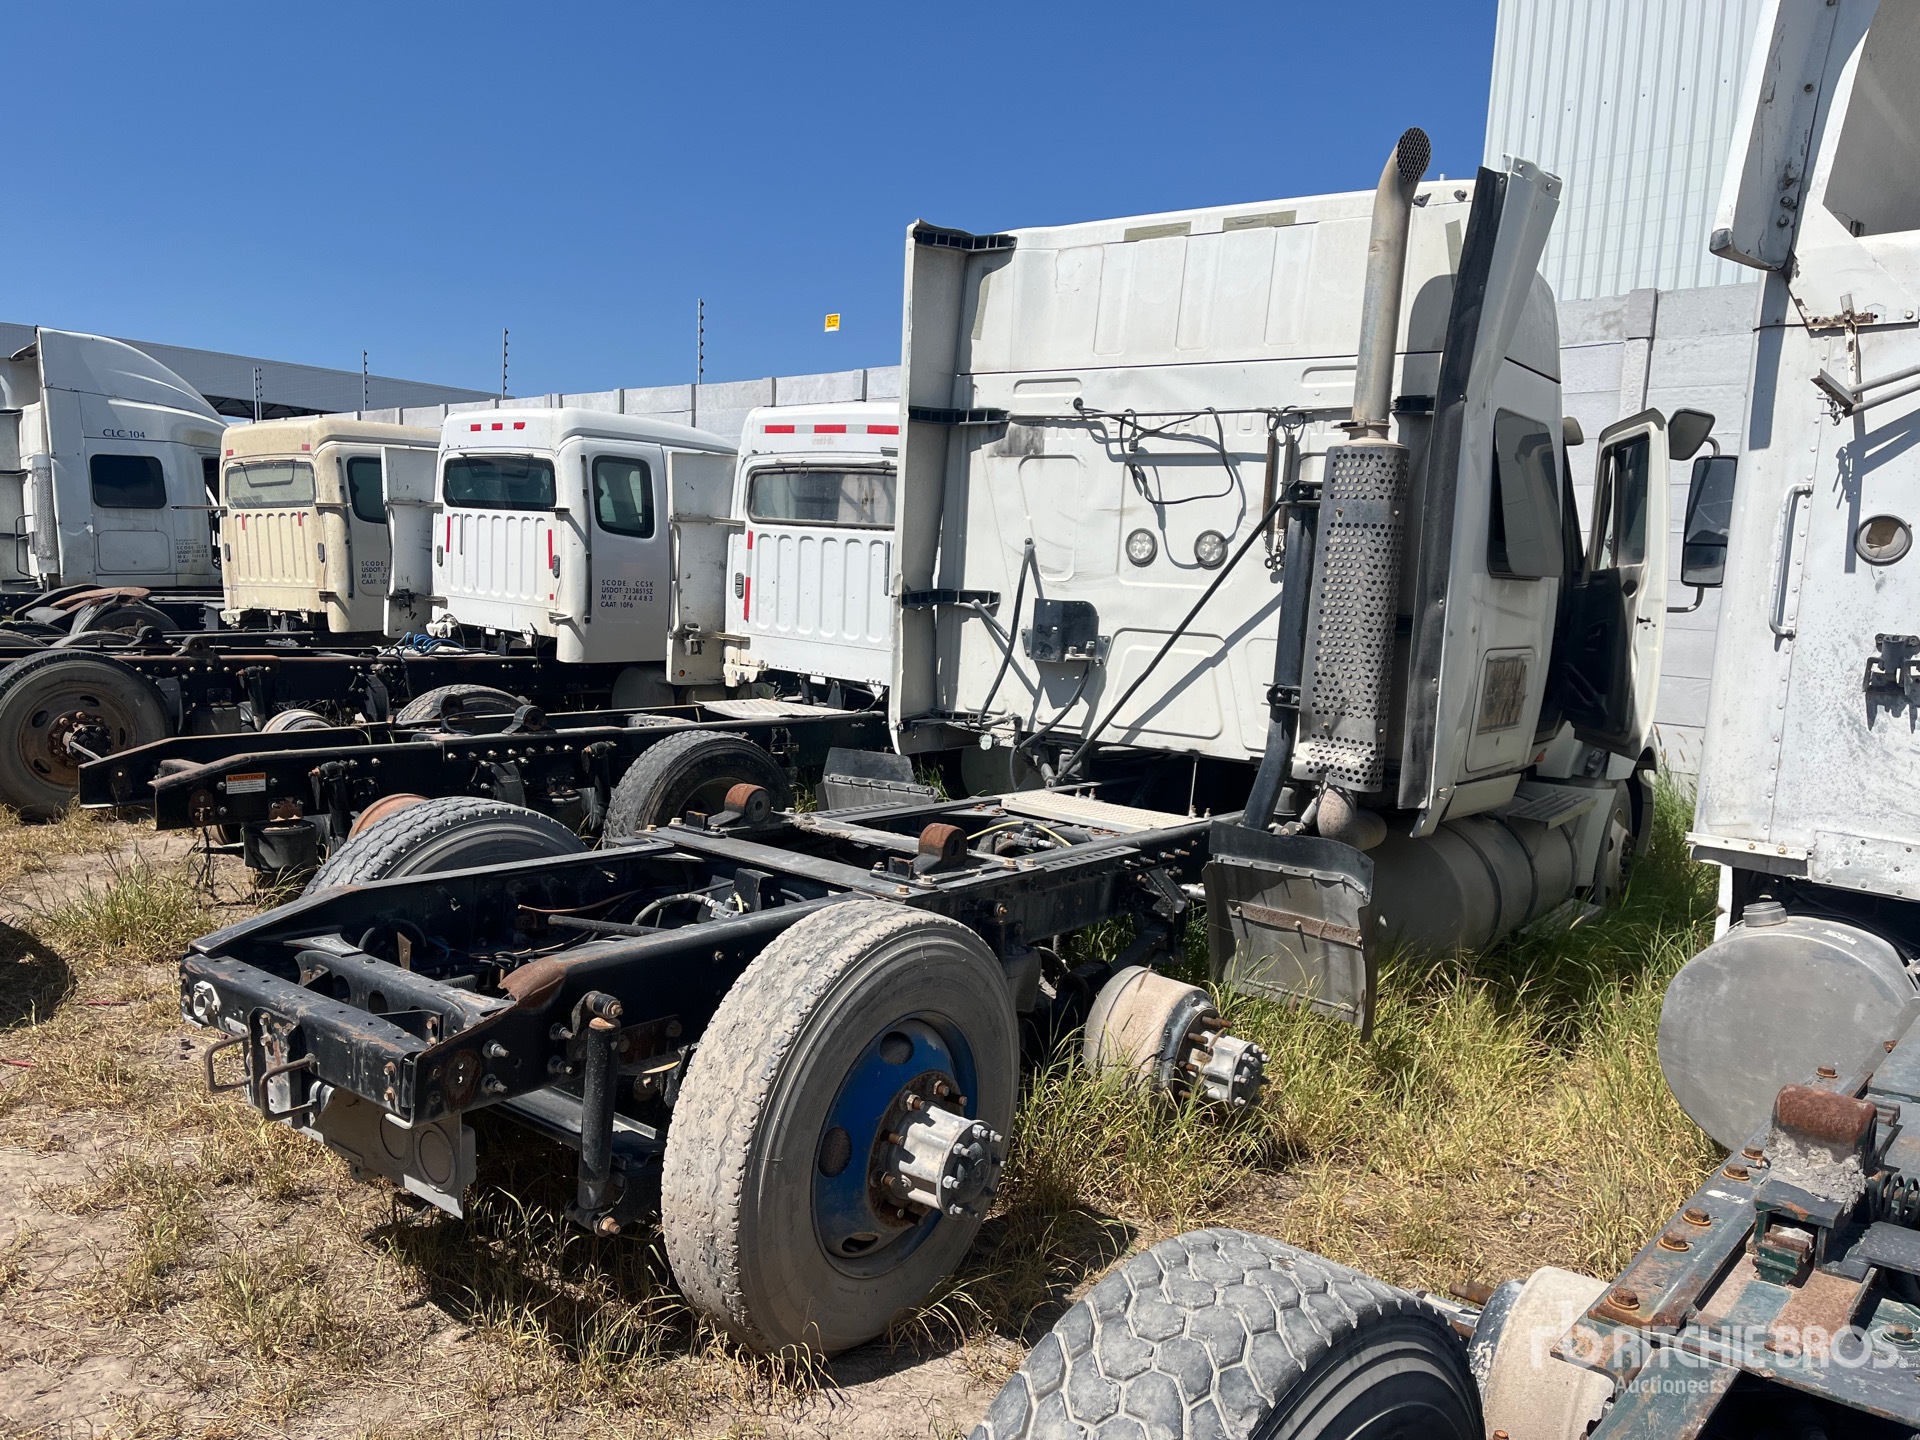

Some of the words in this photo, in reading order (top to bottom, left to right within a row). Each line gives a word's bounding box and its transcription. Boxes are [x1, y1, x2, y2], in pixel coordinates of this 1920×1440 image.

[103, 429, 126, 438] CLC
[128, 430, 145, 439] 104
[601, 579, 629, 587] SCODE:
[635, 580, 654, 588] CCSK
[620, 601, 634, 609] 10F6
